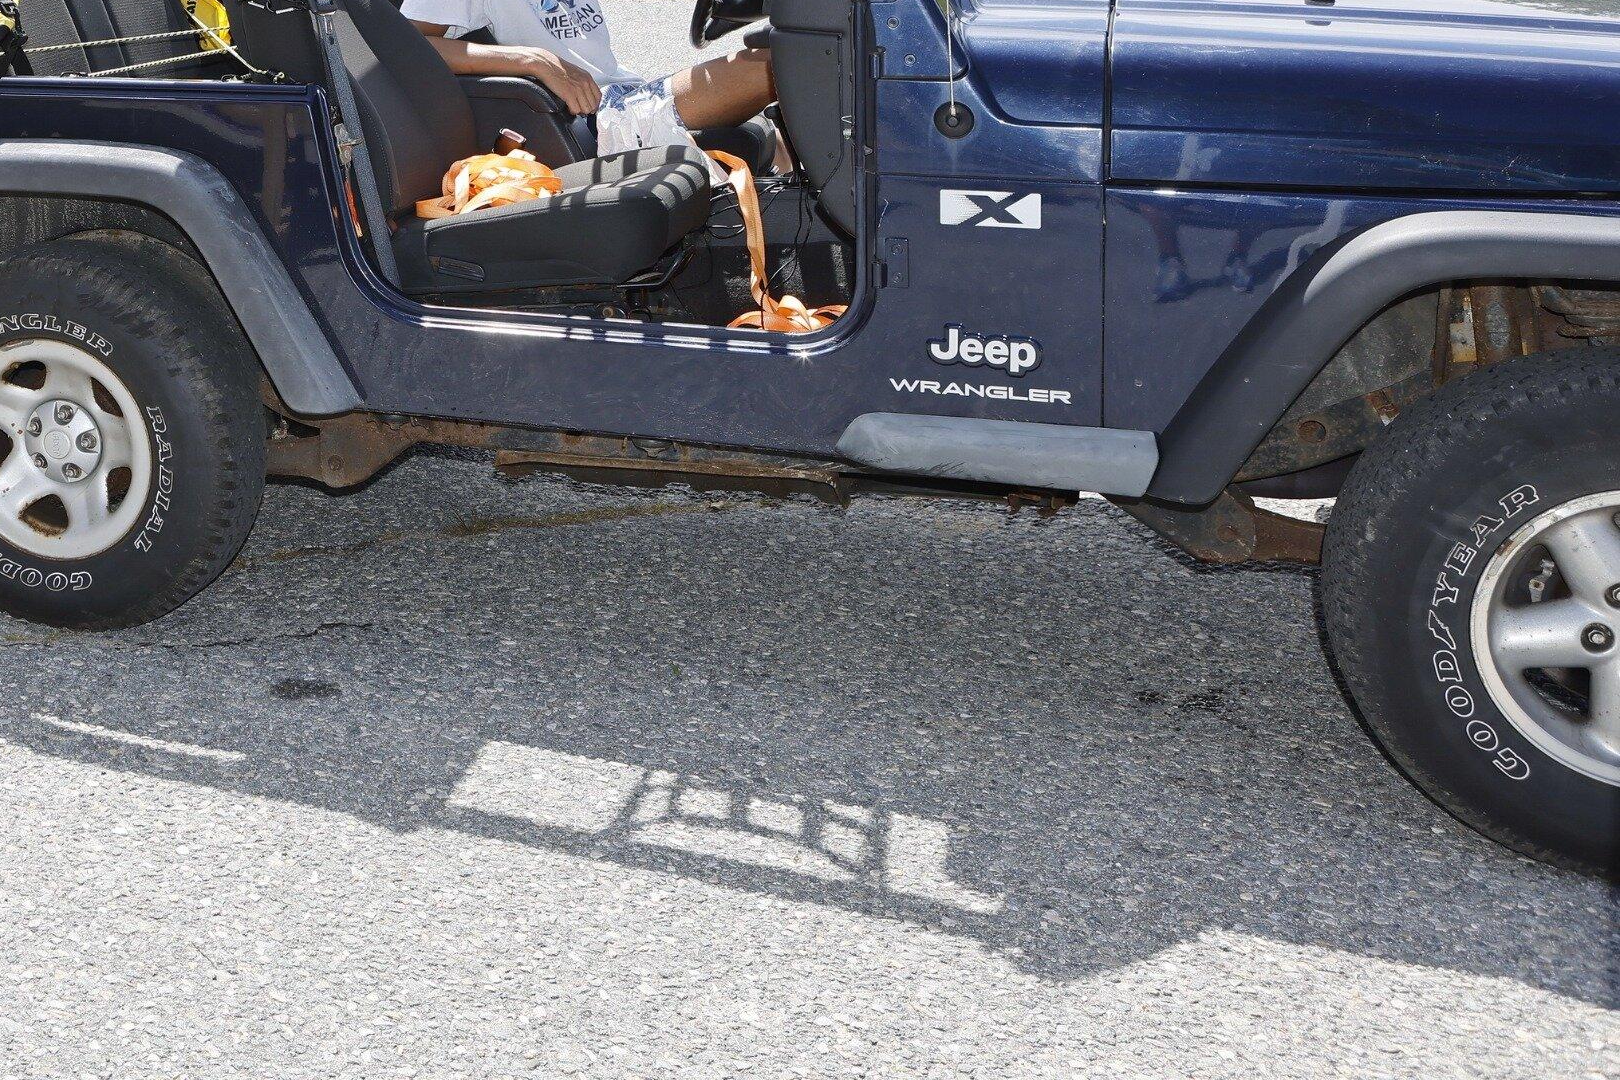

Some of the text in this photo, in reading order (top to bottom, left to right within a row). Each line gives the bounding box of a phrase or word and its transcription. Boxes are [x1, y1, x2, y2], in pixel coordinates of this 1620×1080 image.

[540, 3, 596, 30] MEAN
[550, 14, 604, 40] TER OLO
[929, 327, 1037, 373] Jeep
[889, 377, 1072, 405] WRANGLER
[133, 406, 176, 552] RADIAL
